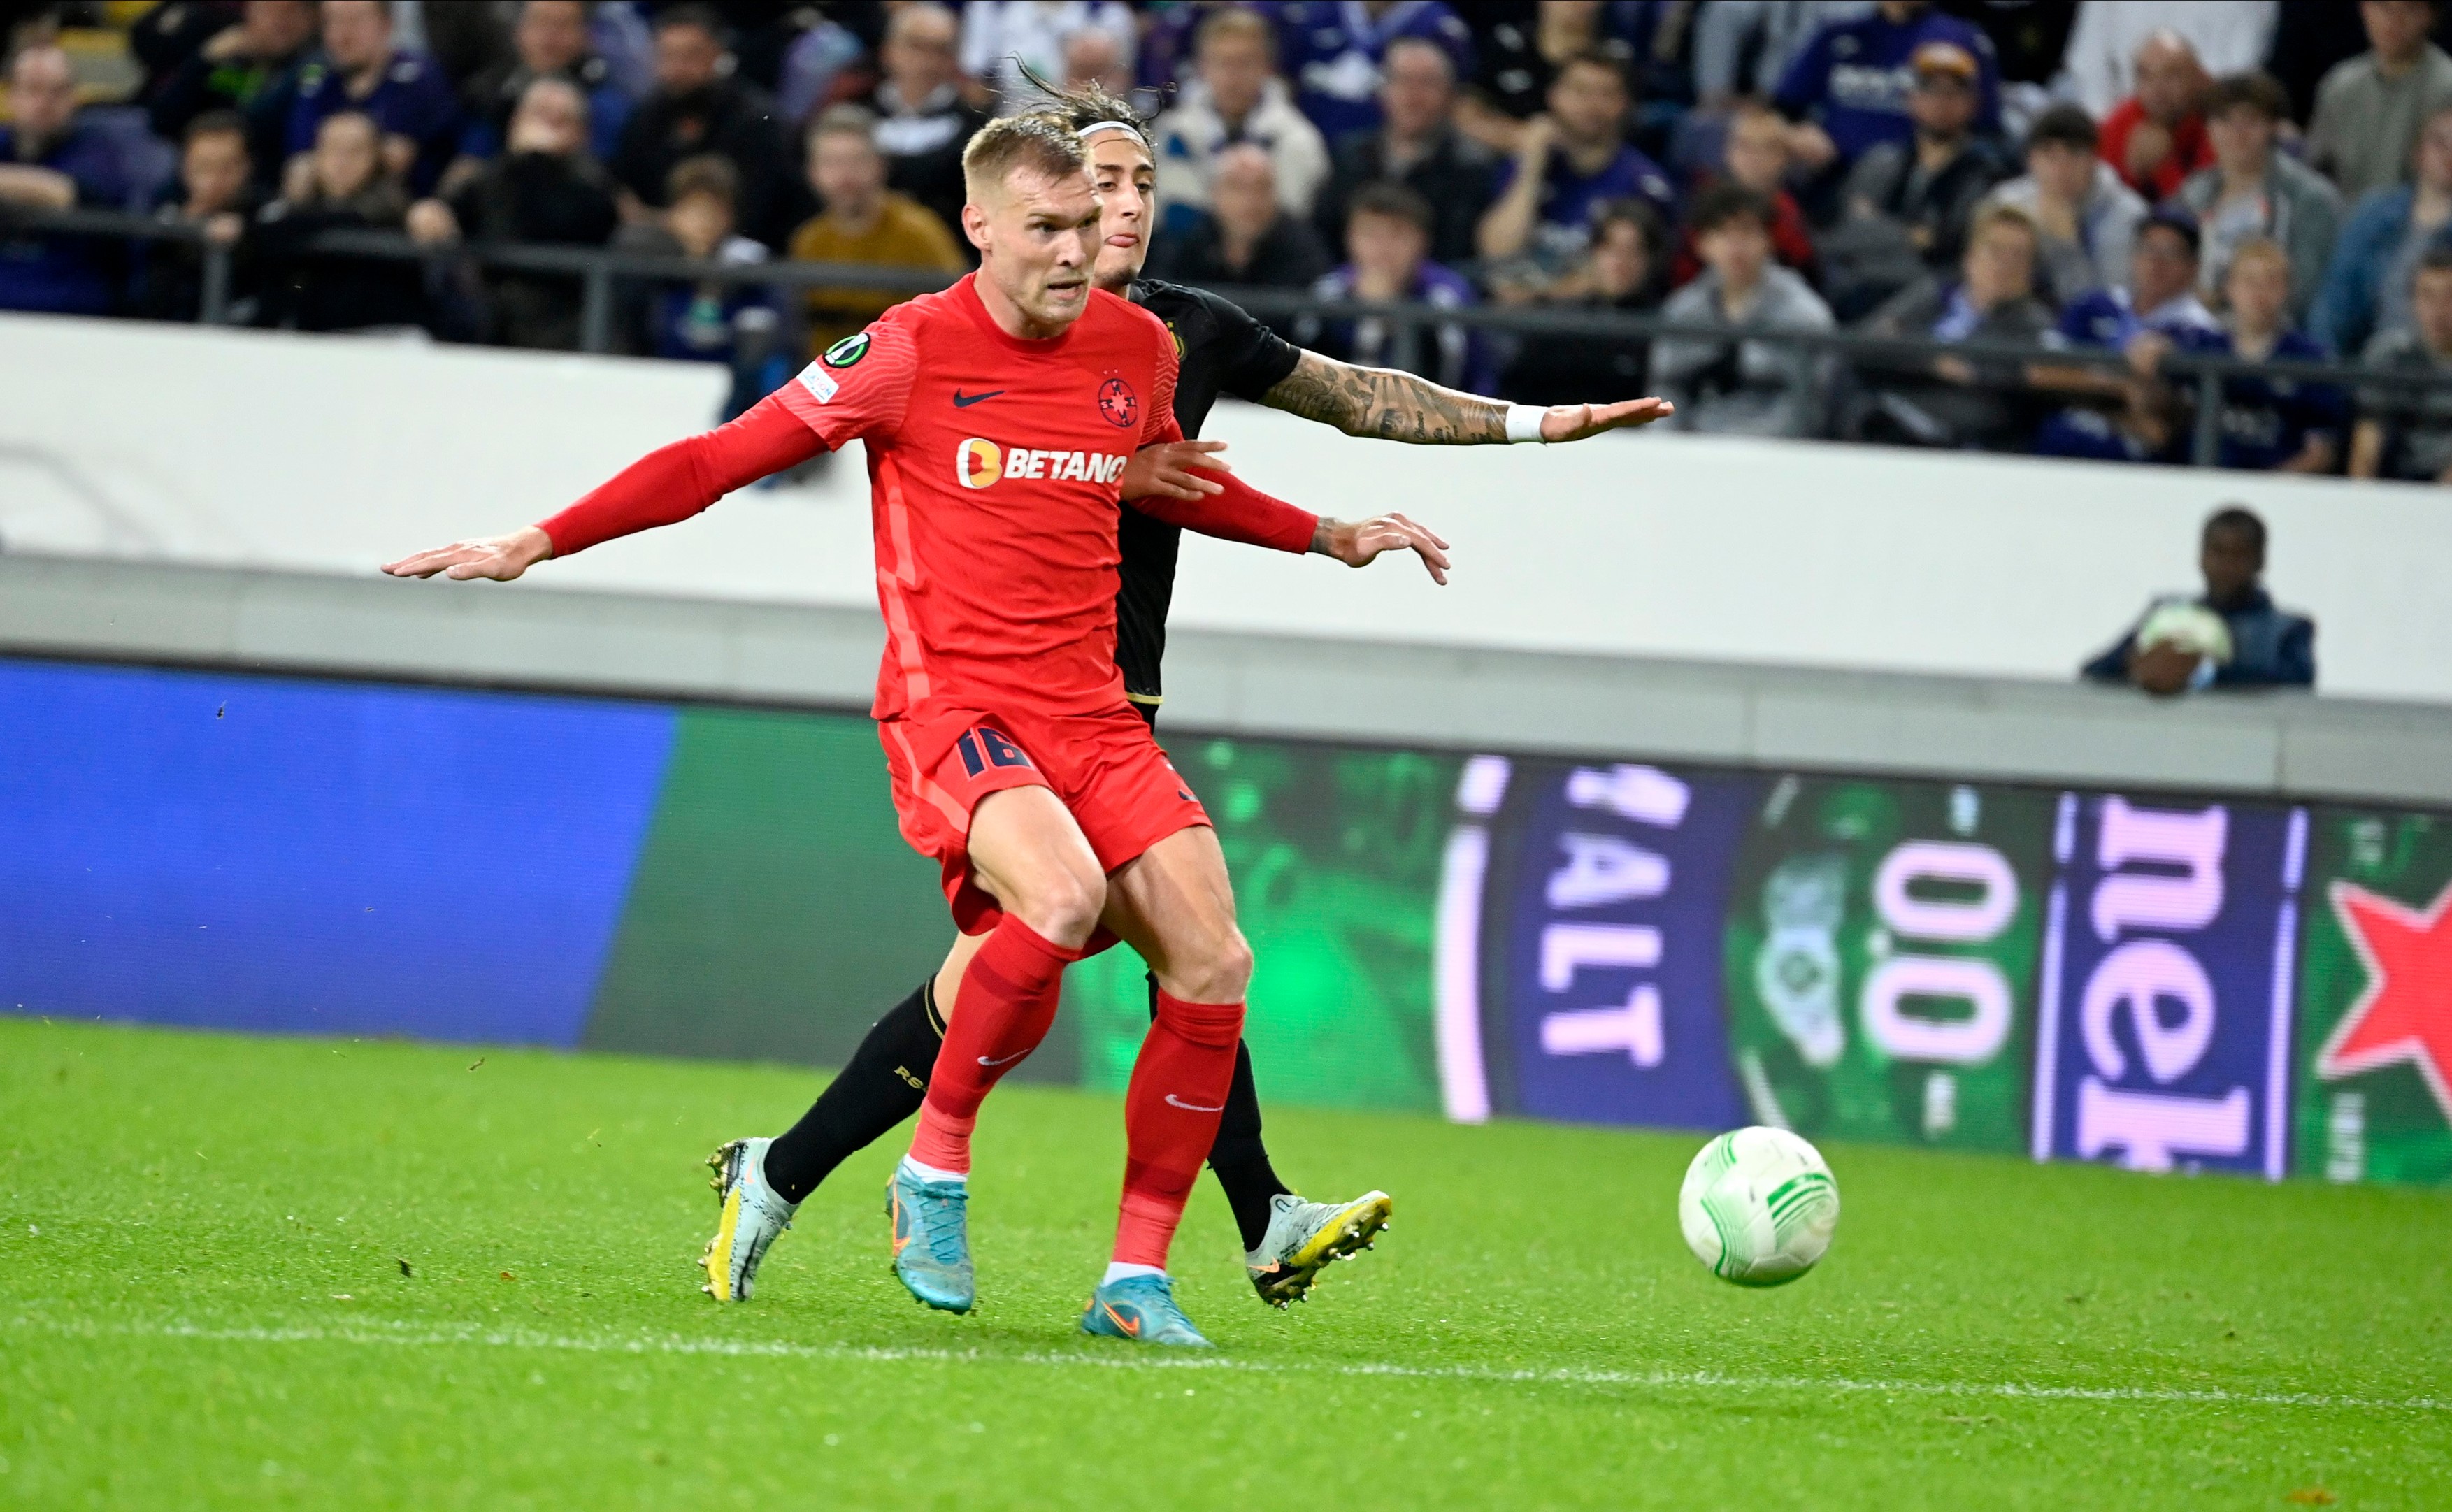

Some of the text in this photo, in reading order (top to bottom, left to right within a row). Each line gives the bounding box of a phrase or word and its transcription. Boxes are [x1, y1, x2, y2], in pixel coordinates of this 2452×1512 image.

[1003, 447, 1128, 484] BETANO
[956, 726, 1033, 779] 16
[894, 1065, 928, 1093] RS
